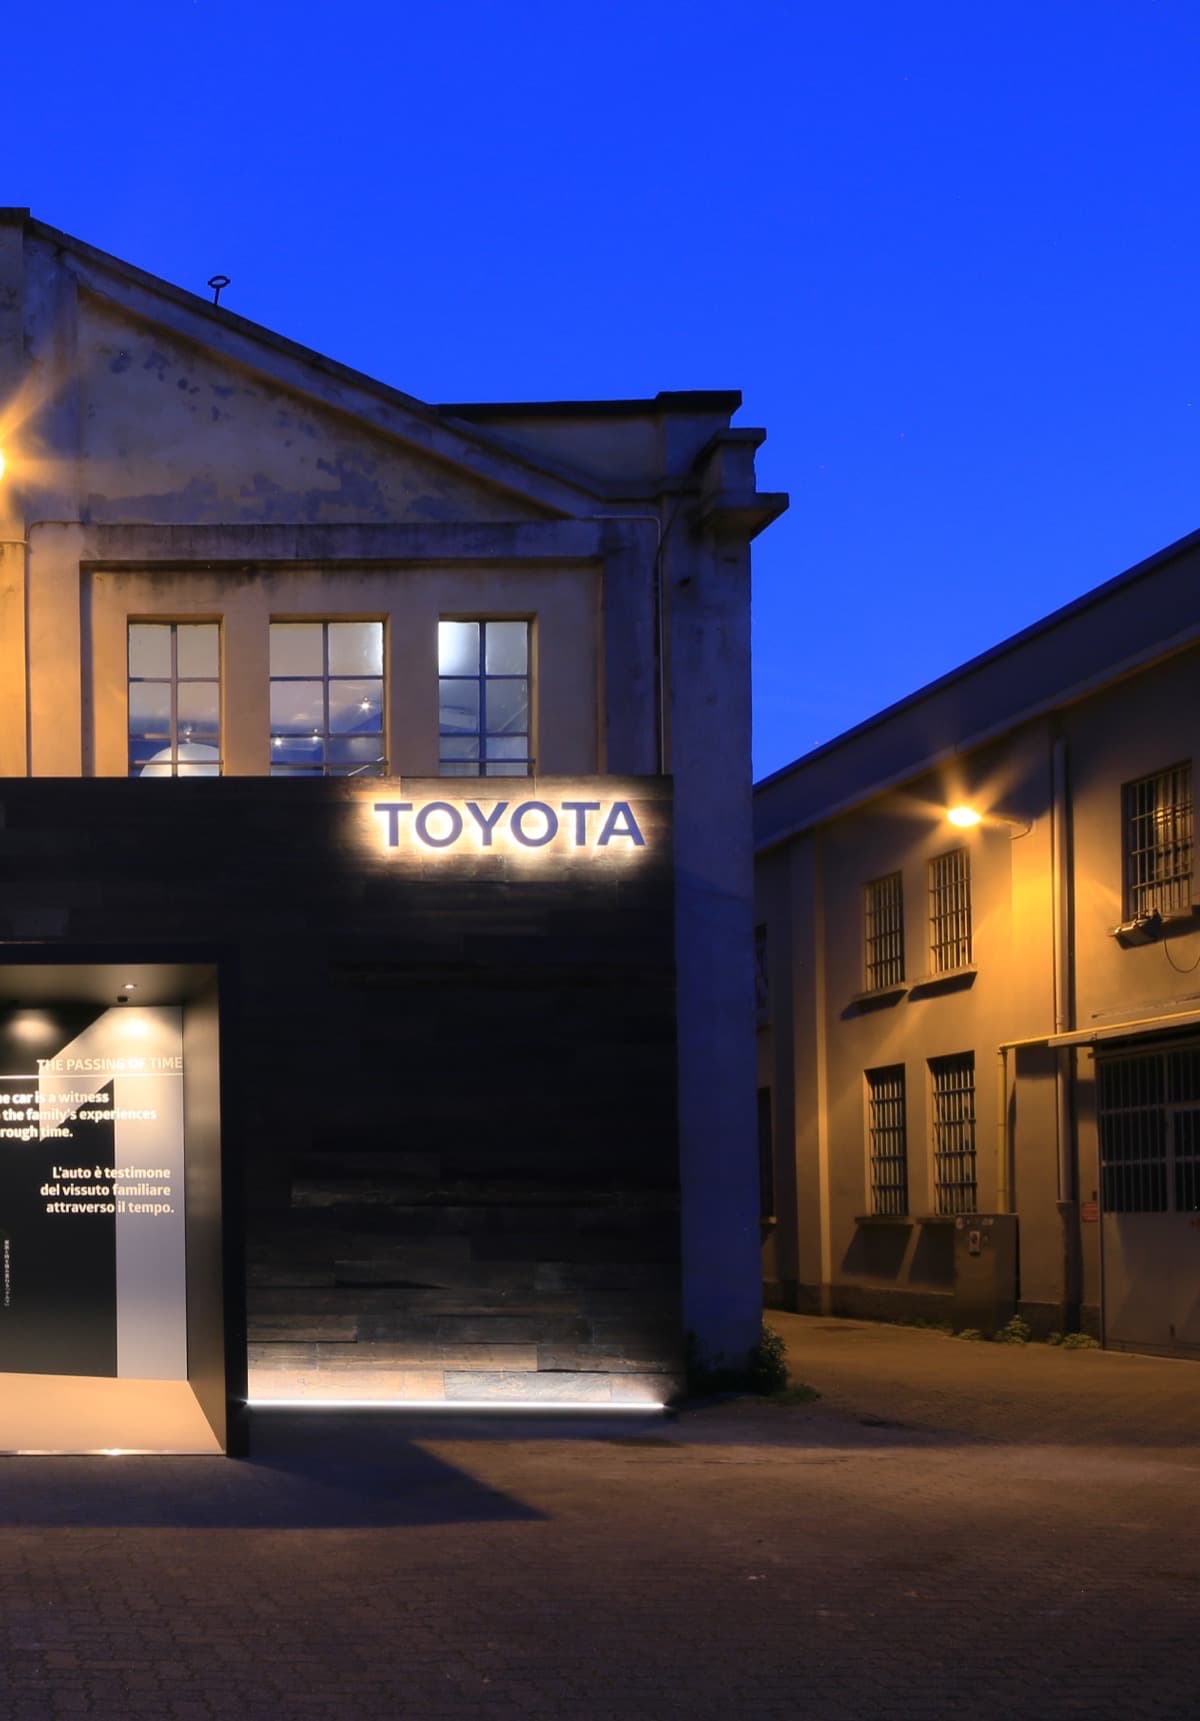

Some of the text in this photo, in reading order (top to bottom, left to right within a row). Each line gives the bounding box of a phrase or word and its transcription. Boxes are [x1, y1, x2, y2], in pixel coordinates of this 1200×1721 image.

[374, 801, 646, 848] TOYOTA
[36, 1056, 183, 1071] THE PASSING OF TIME
[12, 1094, 33, 1105] car
[35, 1091, 46, 1104] is
[48, 1094, 57, 1104] a
[58, 1091, 110, 1104] witness
[2, 1108, 25, 1121] the
[26, 1108, 77, 1123] family's
[79, 1109, 157, 1123] experiences
[39, 1126, 73, 1138] time.
[52, 1165, 171, 1179] L'auto è testimone
[40, 1183, 171, 1196] del vissuto familiare
[46, 1201, 175, 1216] attraverso il tempo.
